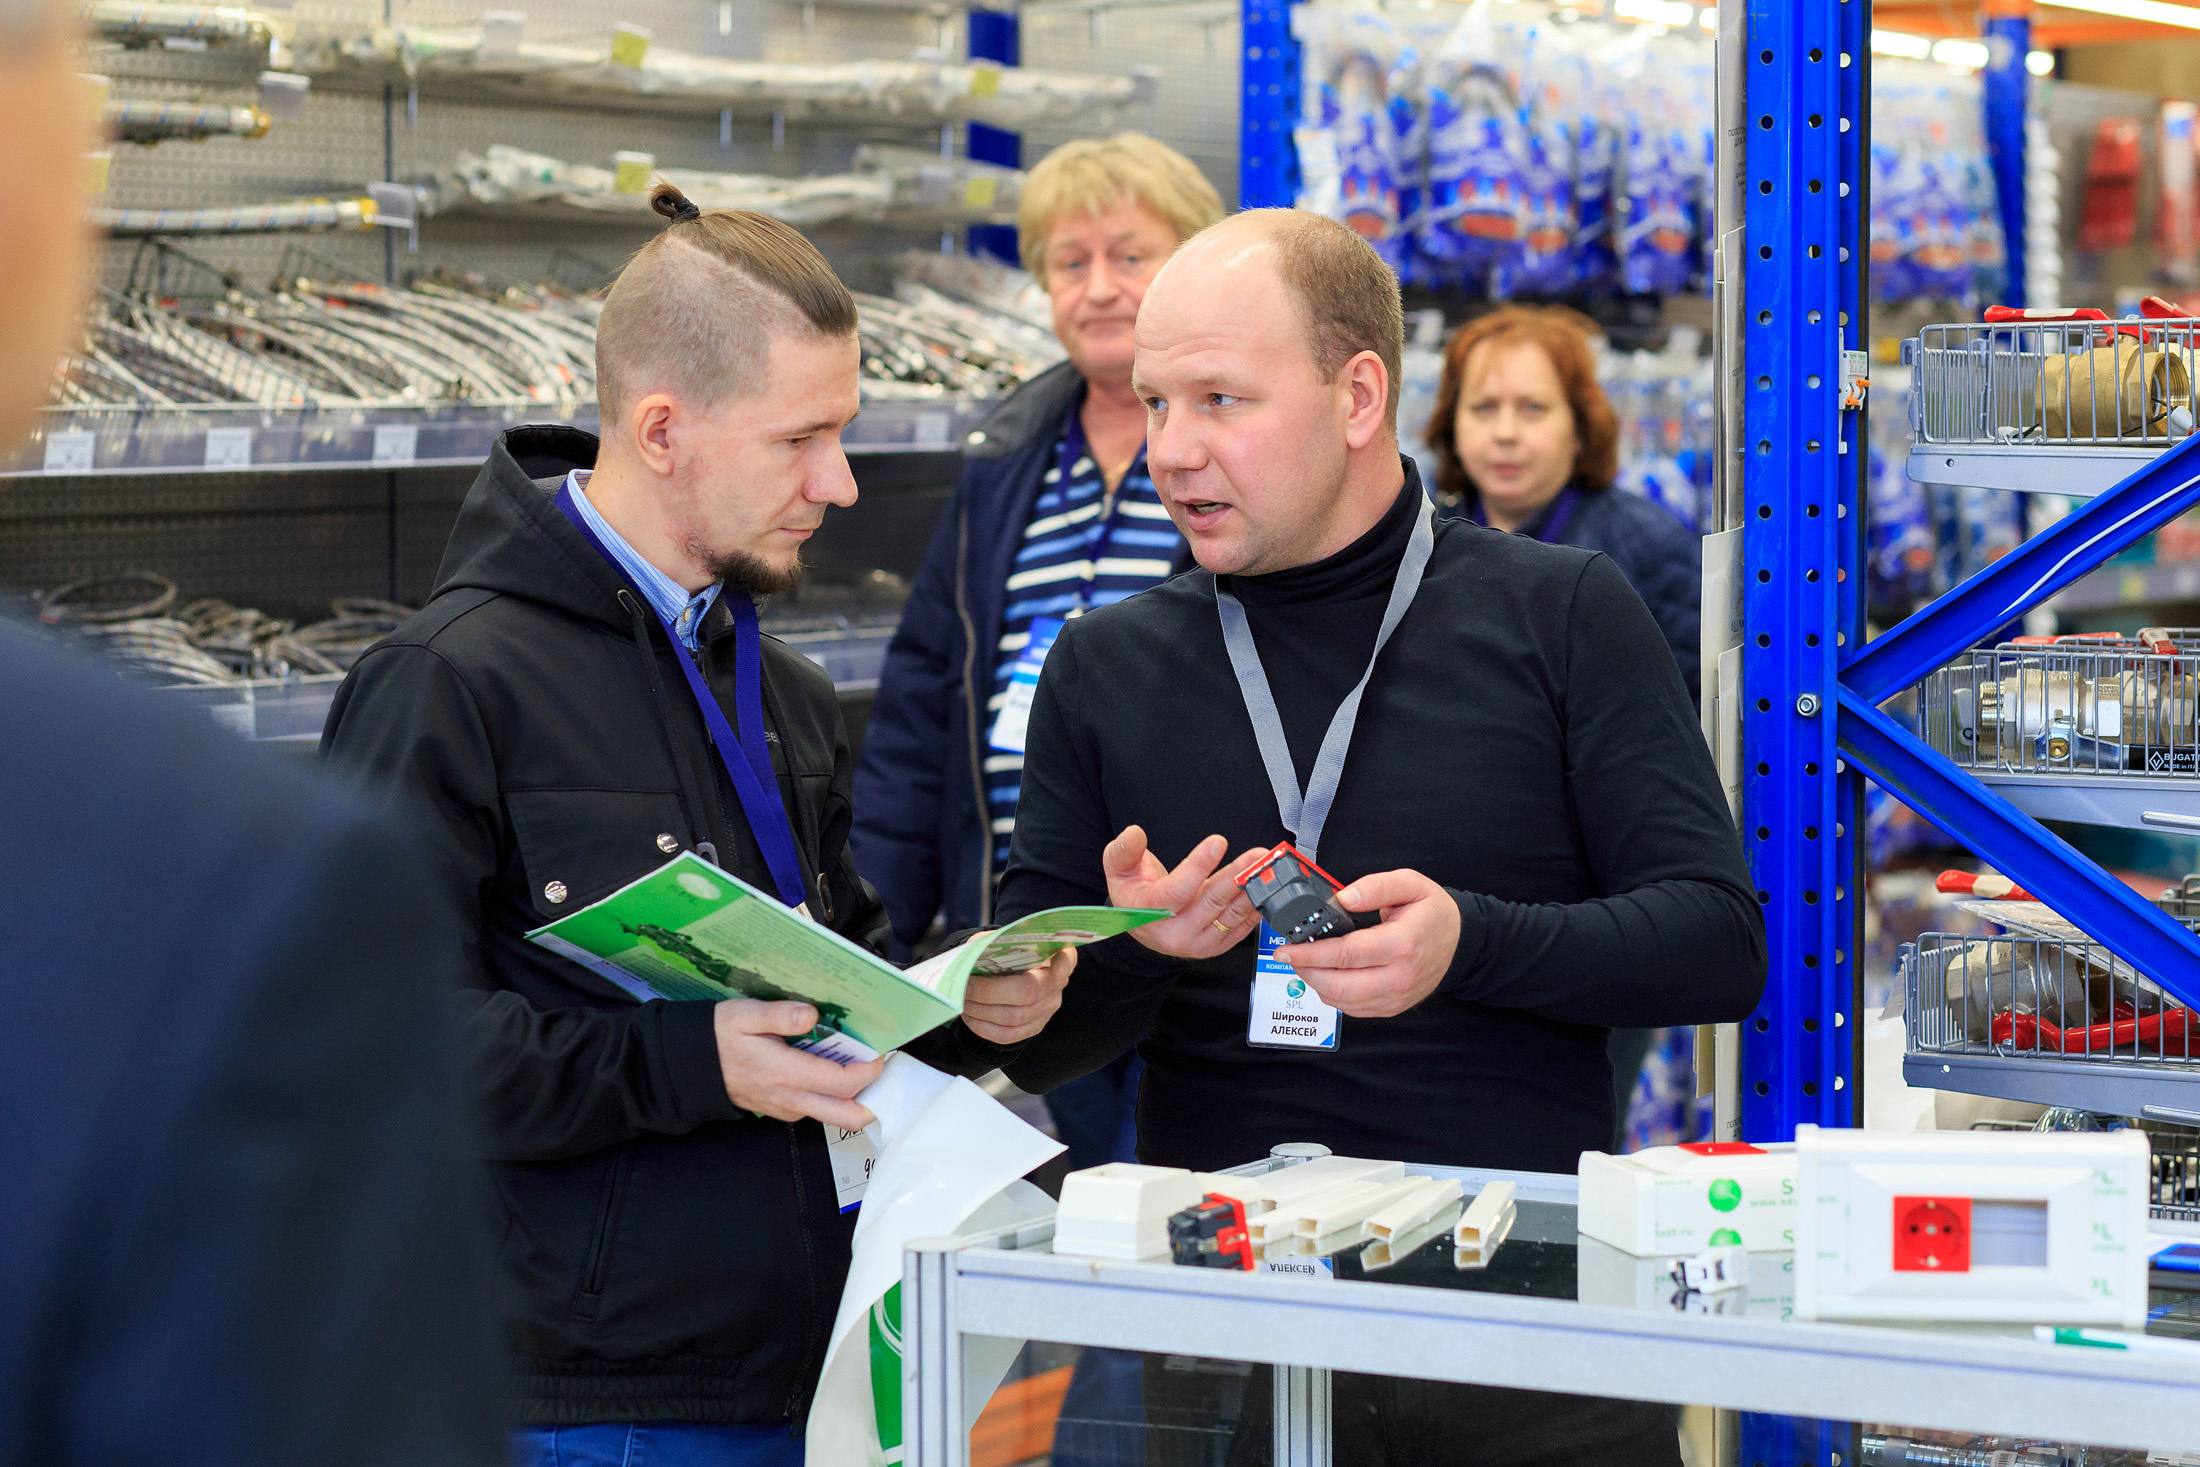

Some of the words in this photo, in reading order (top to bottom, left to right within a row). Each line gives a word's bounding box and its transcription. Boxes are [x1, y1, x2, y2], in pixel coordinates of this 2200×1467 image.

[1265, 963, 1294, 971] КОМПАН
[1286, 1000, 1304, 1010] SPL
[1272, 1011, 1319, 1023] Широков
[1271, 1025, 1317, 1037] АЛЕКСЕЙ
[1781, 1178, 1795, 1195] S
